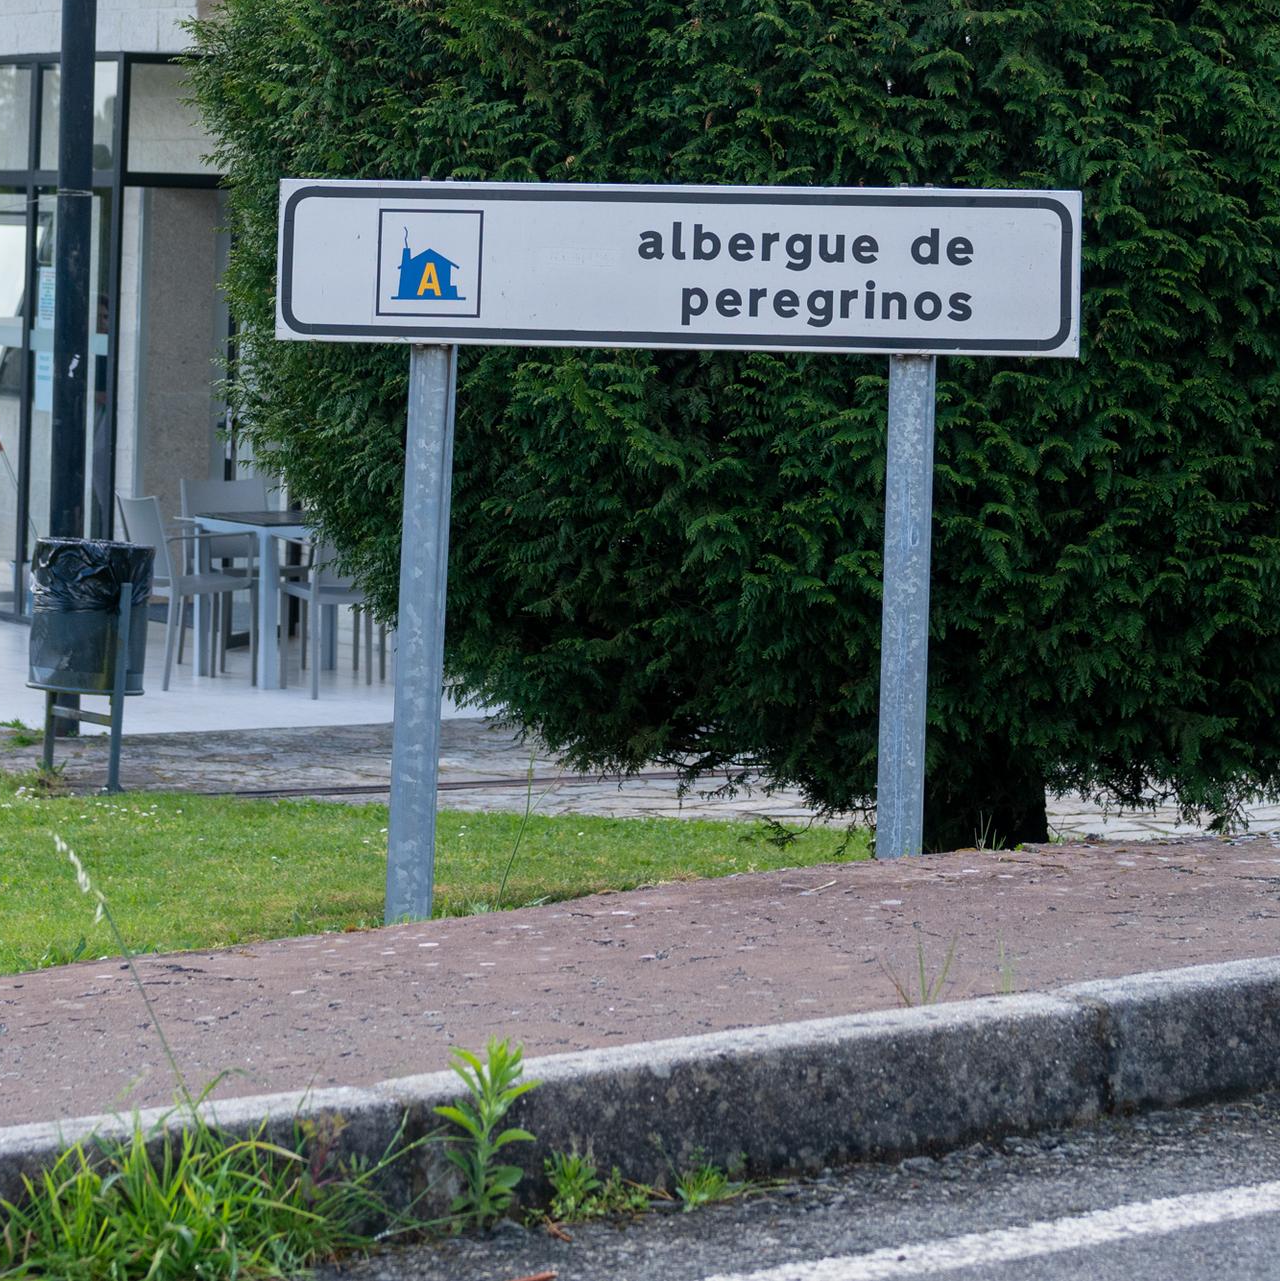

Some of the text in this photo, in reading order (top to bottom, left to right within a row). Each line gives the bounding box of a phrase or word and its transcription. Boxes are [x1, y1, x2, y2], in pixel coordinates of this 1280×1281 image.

[638, 221, 974, 271] albergue de
[417, 262, 441, 296] A
[681, 280, 973, 328] peregrinos
